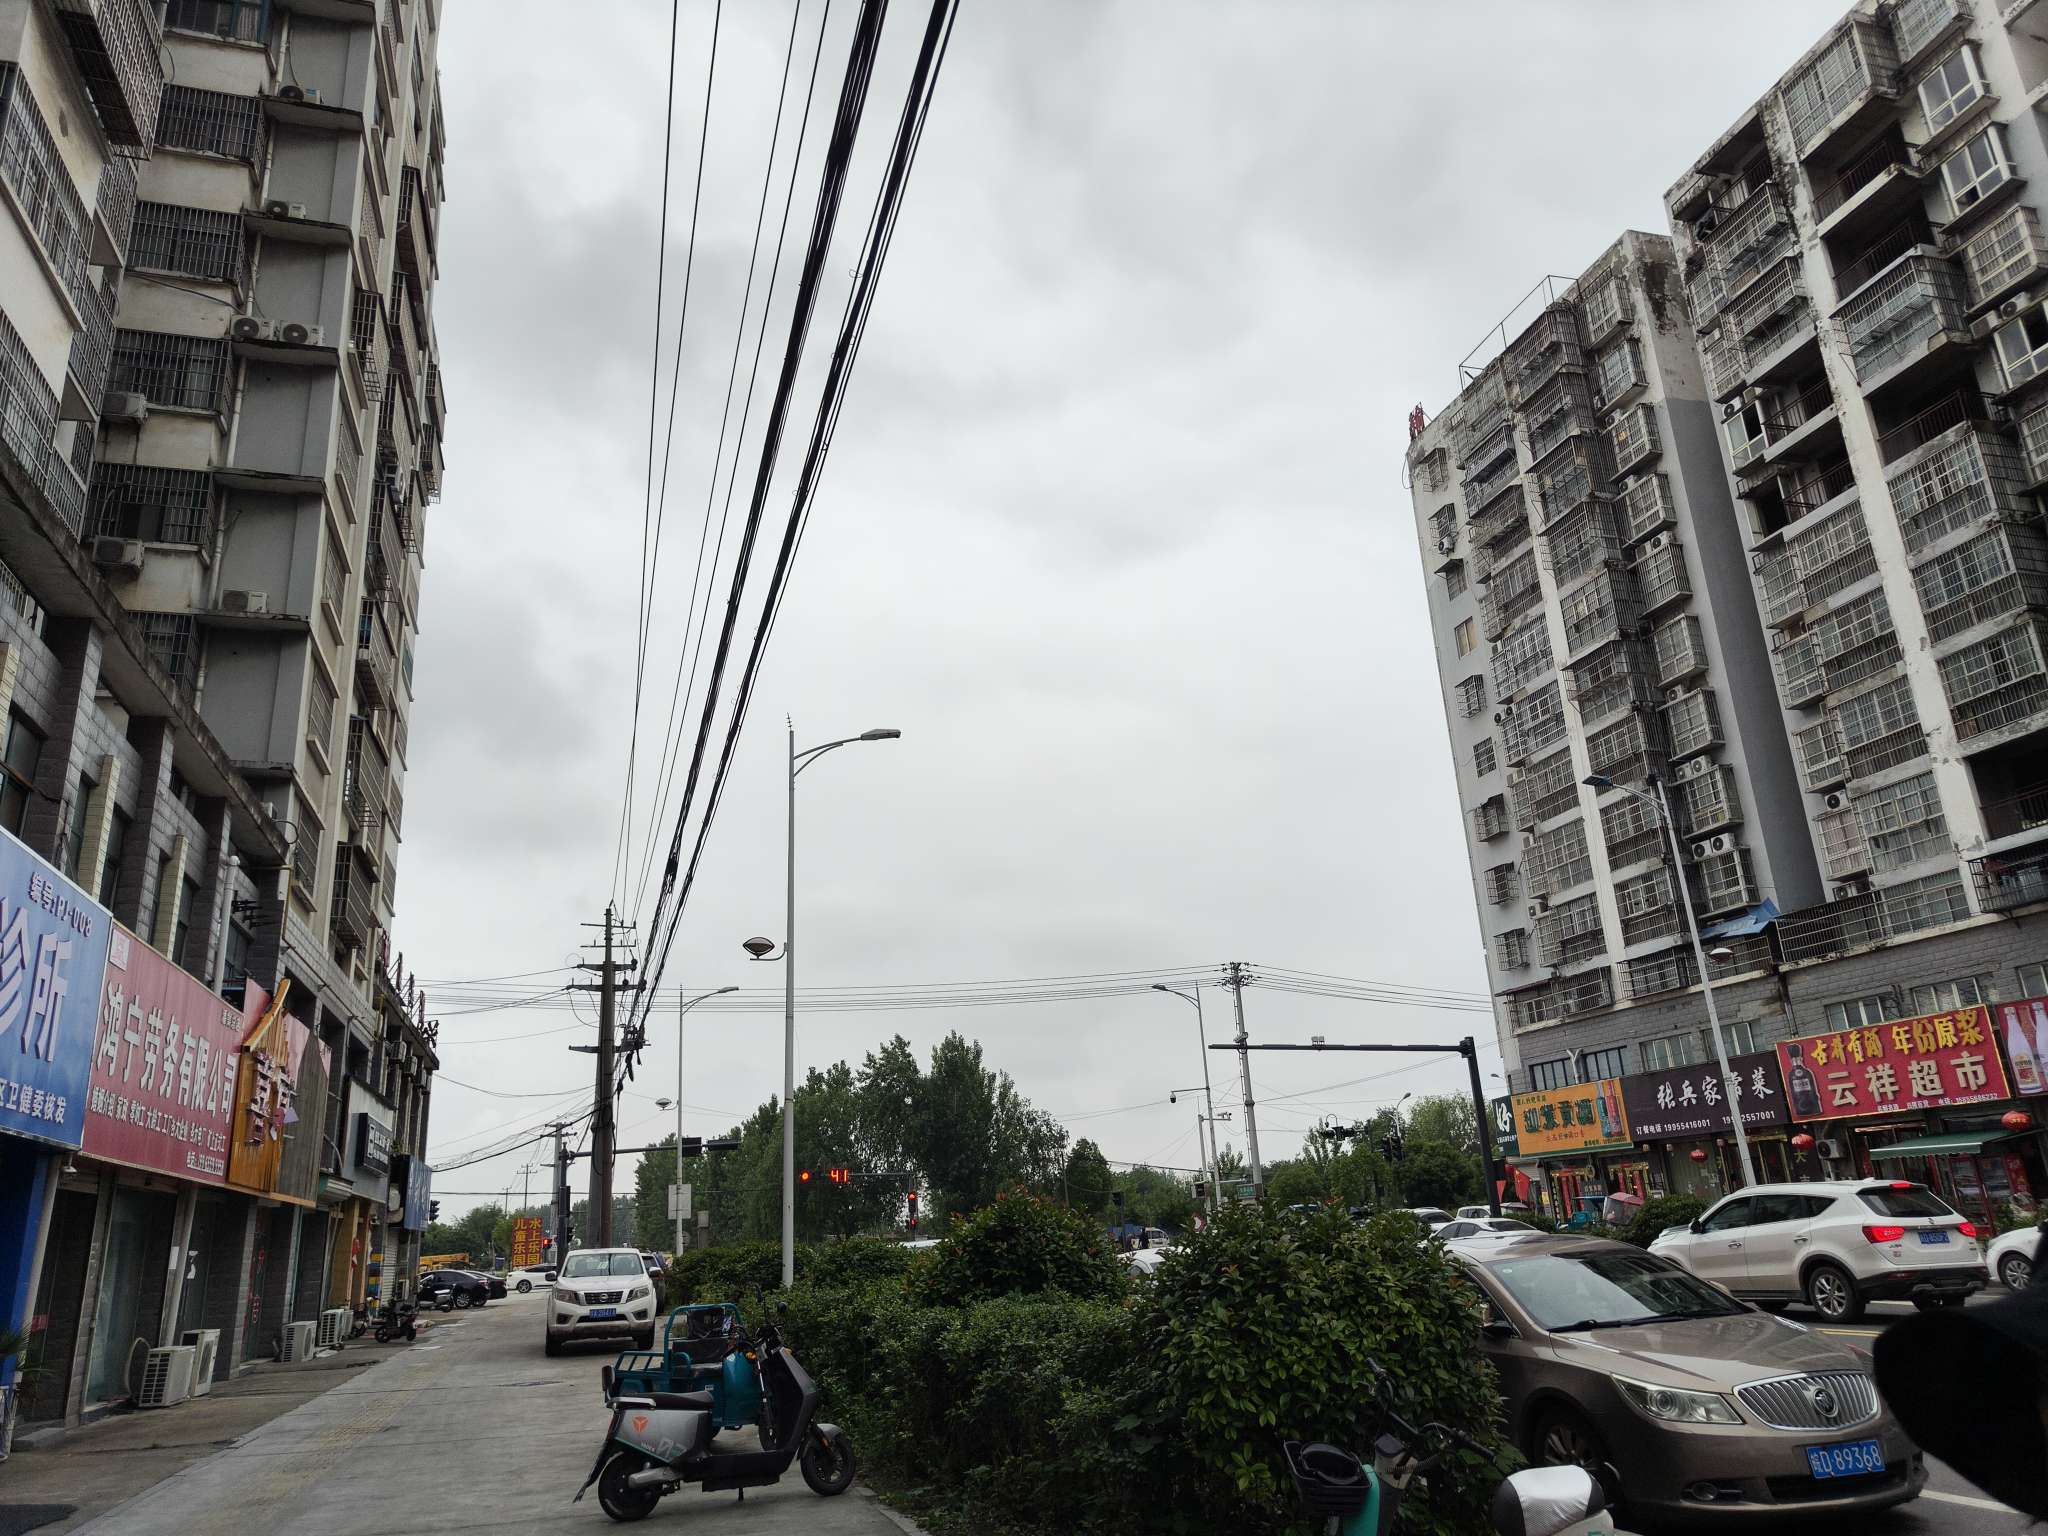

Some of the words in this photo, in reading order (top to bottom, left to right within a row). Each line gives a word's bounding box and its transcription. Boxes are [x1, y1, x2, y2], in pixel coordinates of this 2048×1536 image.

[96, 980, 240, 1124] 鸿宁劳务有限公司
[1811, 1027, 1885, 1066] 古井贡酒
[1892, 1009, 1985, 1055] 年份原浆
[1827, 1051, 1988, 1108] 云祥超市
[1635, 1123, 1662, 1135] 订餐电话
[1664, 1119, 1711, 1132] 19955416001
[1721, 1110, 1775, 1125] 192557001
[830, 1169, 848, 1182] 41
[513, 1218, 528, 1266] 儿童乐园
[527, 1217, 542, 1265] 水上乐园
